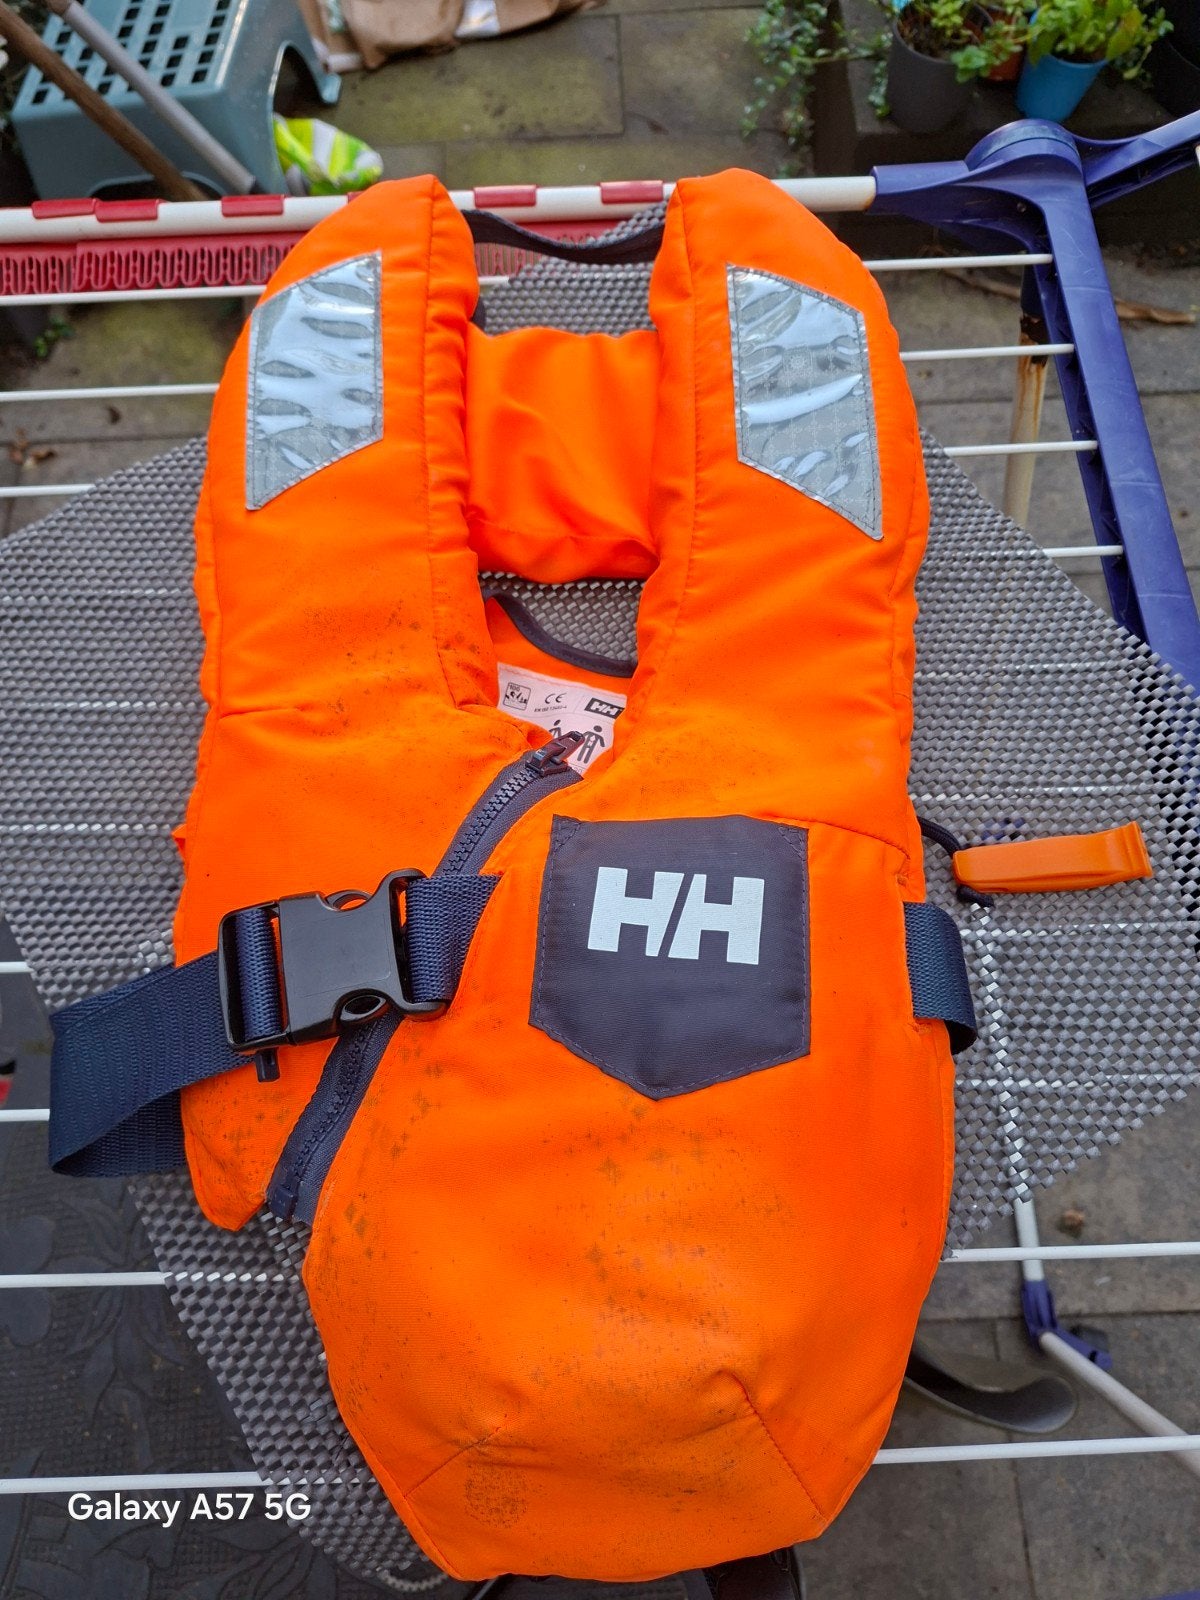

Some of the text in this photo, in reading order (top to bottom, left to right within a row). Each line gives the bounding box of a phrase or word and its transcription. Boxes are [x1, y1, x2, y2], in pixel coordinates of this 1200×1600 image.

[545, 693, 567, 704] CE
[590, 701, 618, 716] HH
[588, 866, 765, 965] HH
